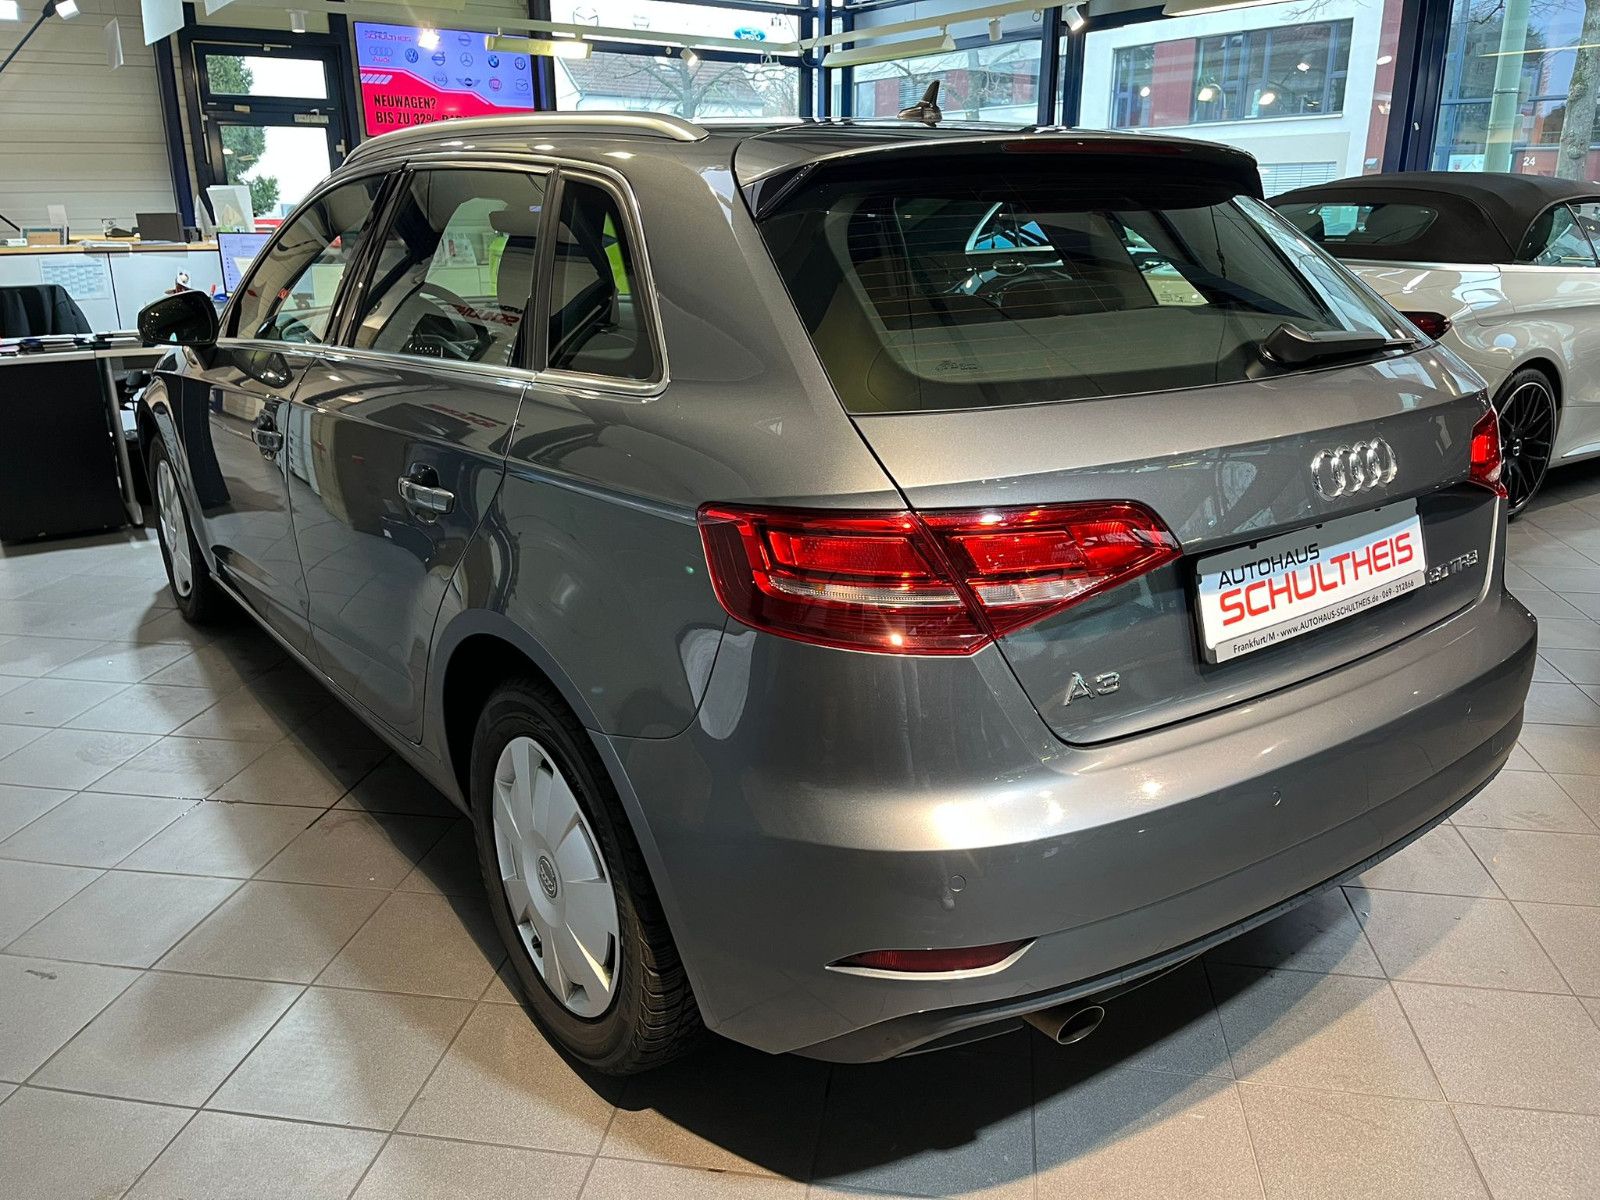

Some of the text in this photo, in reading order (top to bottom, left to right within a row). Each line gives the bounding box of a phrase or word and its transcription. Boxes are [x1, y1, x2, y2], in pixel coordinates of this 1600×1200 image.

[374, 94, 437, 110] NEUWAGEN?
[376, 111, 396, 124] BIS
[398, 112, 410, 125] ZU
[414, 113, 438, 125] 32%
[1523, 156, 1536, 167] 24
[1218, 542, 1320, 590] AUTOHAUS
[1219, 532, 1414, 627] SCHULTHEIS
[1233, 631, 1276, 654] Frankfurt/M
[1280, 594, 1379, 638] www.AUTOHAUS-SCHULTHEIS.de
[1381, 587, 1392, 599] 069
[1064, 671, 1121, 706] A3
